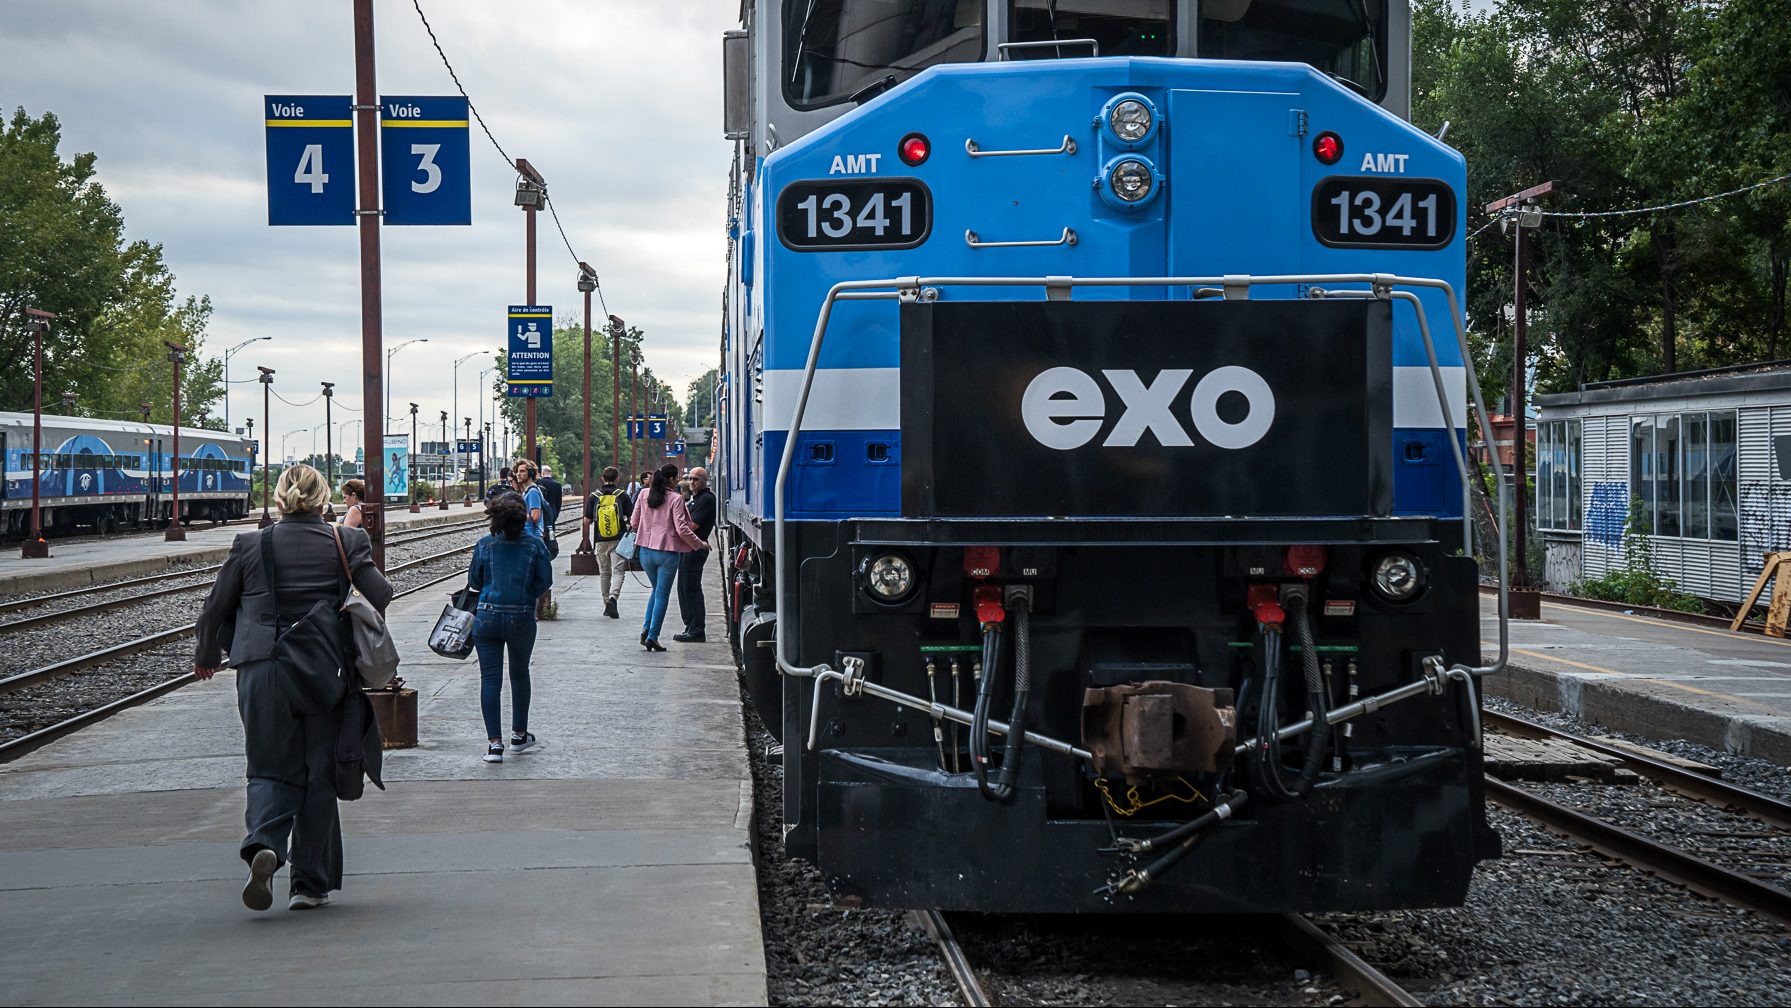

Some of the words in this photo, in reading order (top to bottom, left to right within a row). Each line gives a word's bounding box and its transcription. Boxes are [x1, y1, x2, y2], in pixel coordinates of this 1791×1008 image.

[272, 103, 304, 117] Voie
[389, 103, 421, 118] Voie
[294, 144, 329, 194] 4
[411, 143, 442, 194] 3
[829, 153, 882, 175] AMT
[1360, 152, 1410, 173] AMT
[797, 192, 911, 238] 1341
[1330, 190, 1437, 237] 1341
[1021, 365, 1276, 450] exo
[653, 422, 661, 433] 3
